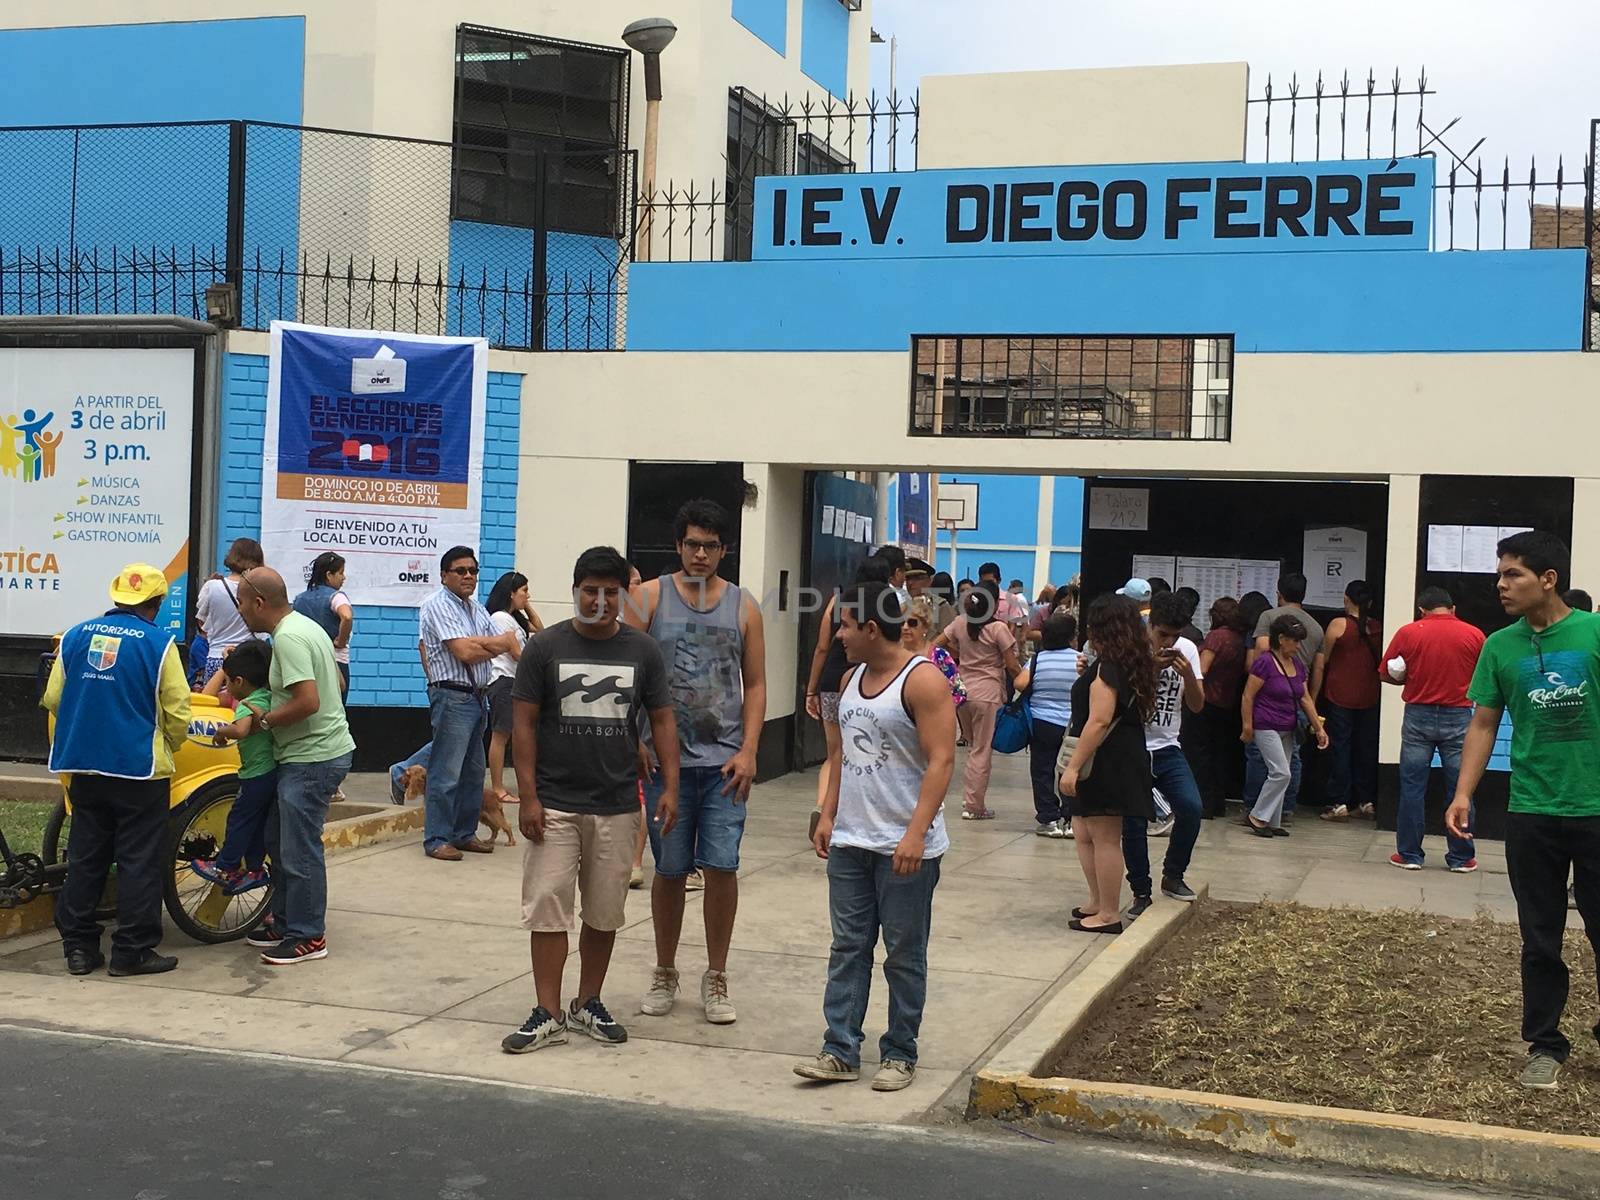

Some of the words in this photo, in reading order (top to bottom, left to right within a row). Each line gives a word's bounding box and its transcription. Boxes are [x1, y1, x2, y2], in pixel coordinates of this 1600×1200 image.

[773, 187, 904, 246] I.E.V.
[946, 180, 1148, 243] DIEGO
[1164, 159, 1416, 240] FERRÉ
[75, 395, 84, 408] A
[88, 395, 134, 408] PARTIR
[138, 396, 163, 409] DEL
[310, 395, 443, 418] ELECCIONES
[70, 410, 83, 429] 3
[89, 409, 115, 430] de
[120, 410, 166, 430] abril
[310, 412, 443, 435] GENERALES
[83, 439, 97, 460] 3
[105, 444, 151, 466] p.m.
[308, 430, 440, 475] 2016
[92, 474, 140, 489] MÚSICA
[304, 477, 367, 491] DOMINGO
[371, 481, 383, 492] 10
[386, 482, 402, 493] DE
[405, 483, 441, 495] ABRIL
[90, 494, 141, 507] DANZAS
[304, 488, 321, 499] DE
[323, 490, 351, 500] 8:00
[378, 494, 385, 502] a
[388, 494, 415, 504] 4:00
[417, 495, 441, 505] P.M.
[66, 511, 105, 524] SHOW
[108, 512, 164, 525] INFANTIL
[315, 518, 396, 533] BIENVENIDO
[399, 523, 408, 534] A
[412, 524, 427, 534] TU
[67, 529, 161, 544] GASTRONOMÍA
[304, 532, 345, 544] LOCAL
[349, 534, 363, 545] DE
[370, 535, 437, 549] VOTACIÓN
[399, 573, 429, 583] ONPE
[170, 585, 182, 629] BIEN
[82, 624, 145, 638] AUTORIZADO
